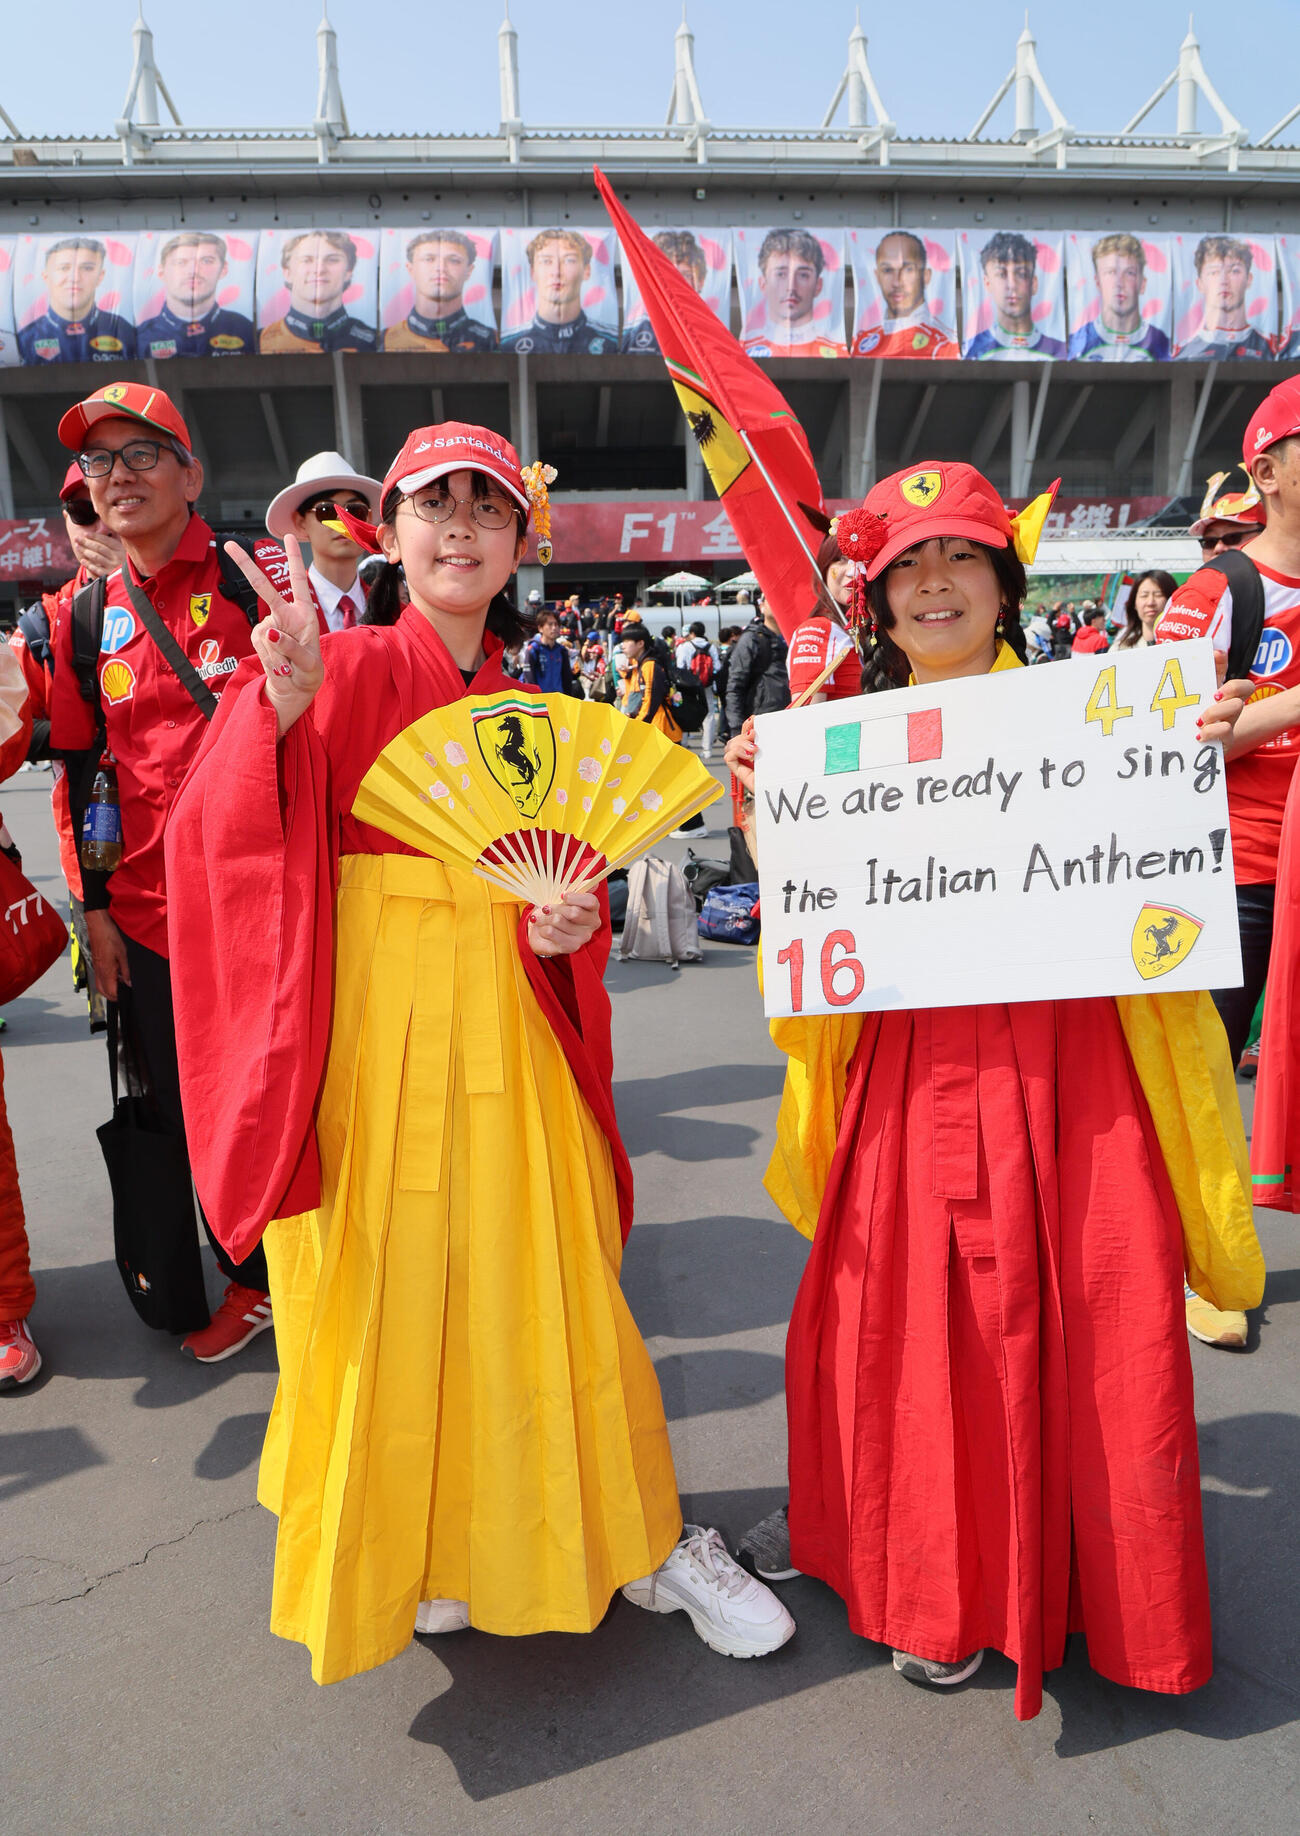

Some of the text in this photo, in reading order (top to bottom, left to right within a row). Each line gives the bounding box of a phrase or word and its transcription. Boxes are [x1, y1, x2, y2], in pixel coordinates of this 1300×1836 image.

[433, 435, 517, 472] Santander
[0, 542, 52, 572] 中継!
[255, 545, 283, 558] aws
[103, 616, 130, 653] hp
[797, 644, 819, 654] ZCG
[765, 744, 1221, 824] We are ready to sing
[782, 828, 1228, 914] the Italian Anthem!
[777, 929, 865, 1013] 16
